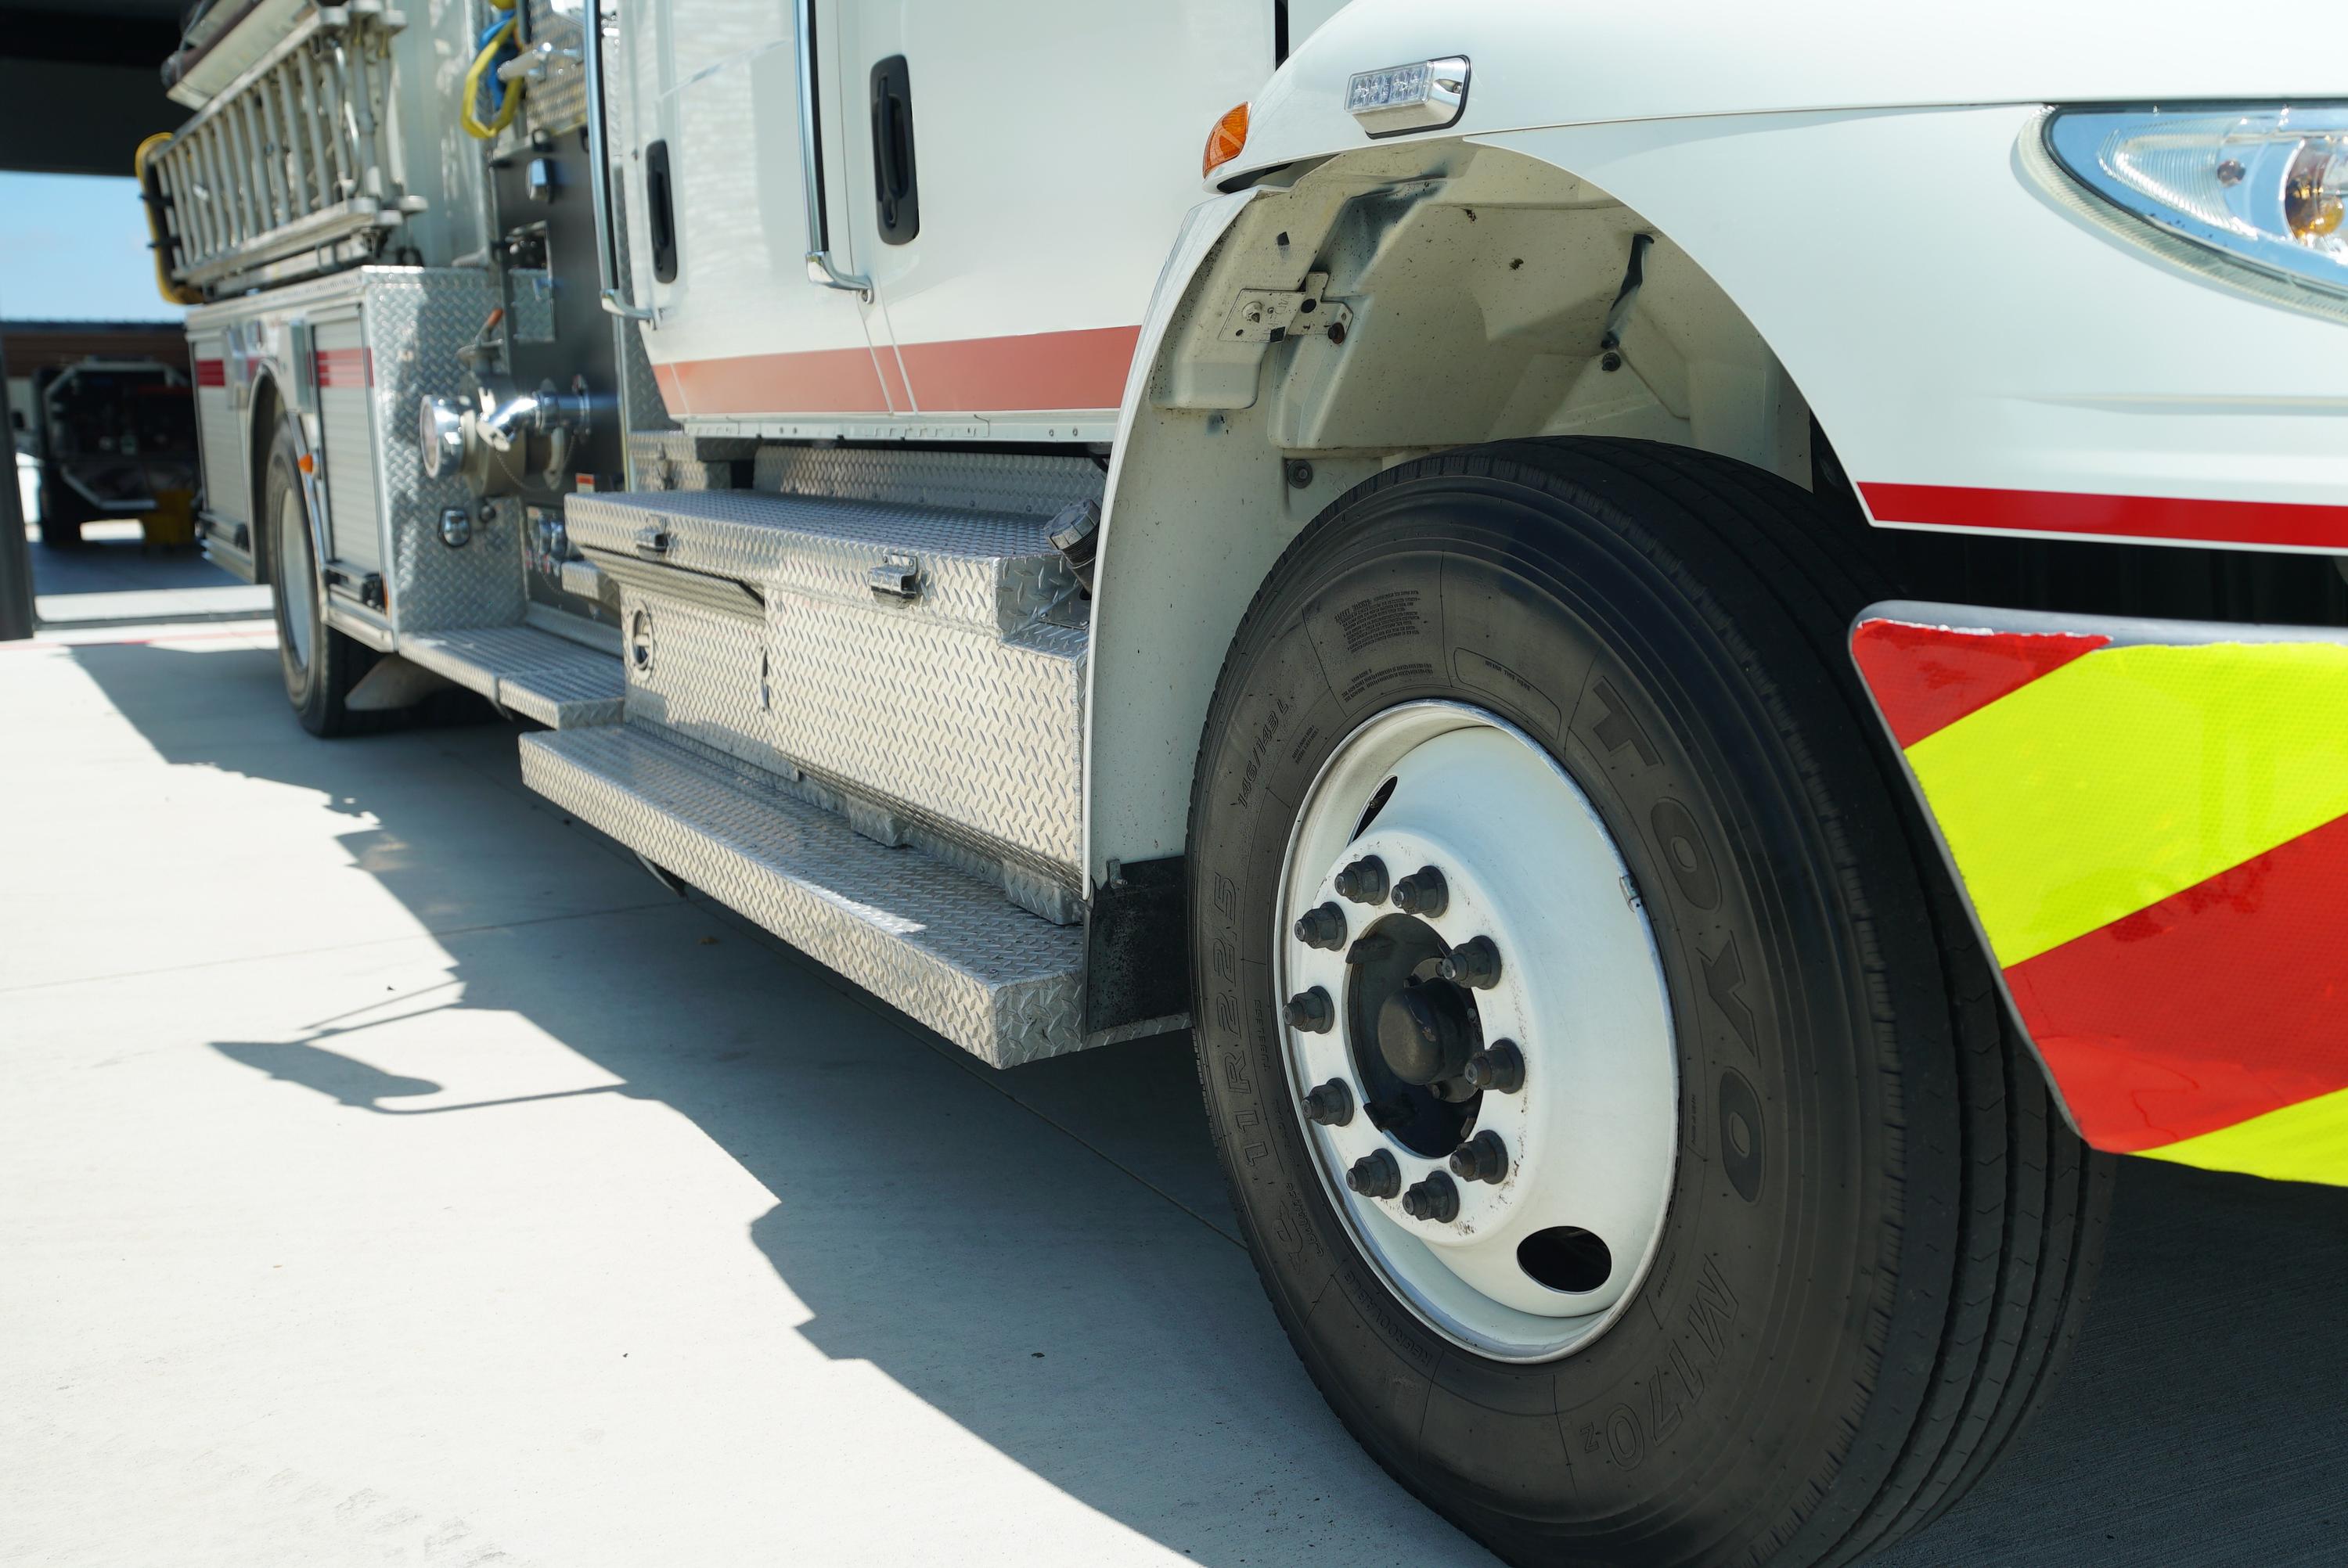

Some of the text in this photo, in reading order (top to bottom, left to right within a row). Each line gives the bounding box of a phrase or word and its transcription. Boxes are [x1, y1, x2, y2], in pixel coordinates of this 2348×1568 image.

[1237, 710, 1281, 810] 146/143
[1593, 674, 1766, 1207] TOYO
[1254, 999, 1270, 1073] TUBELESS
[1343, 1269, 1433, 1368] REGROOVABLE
